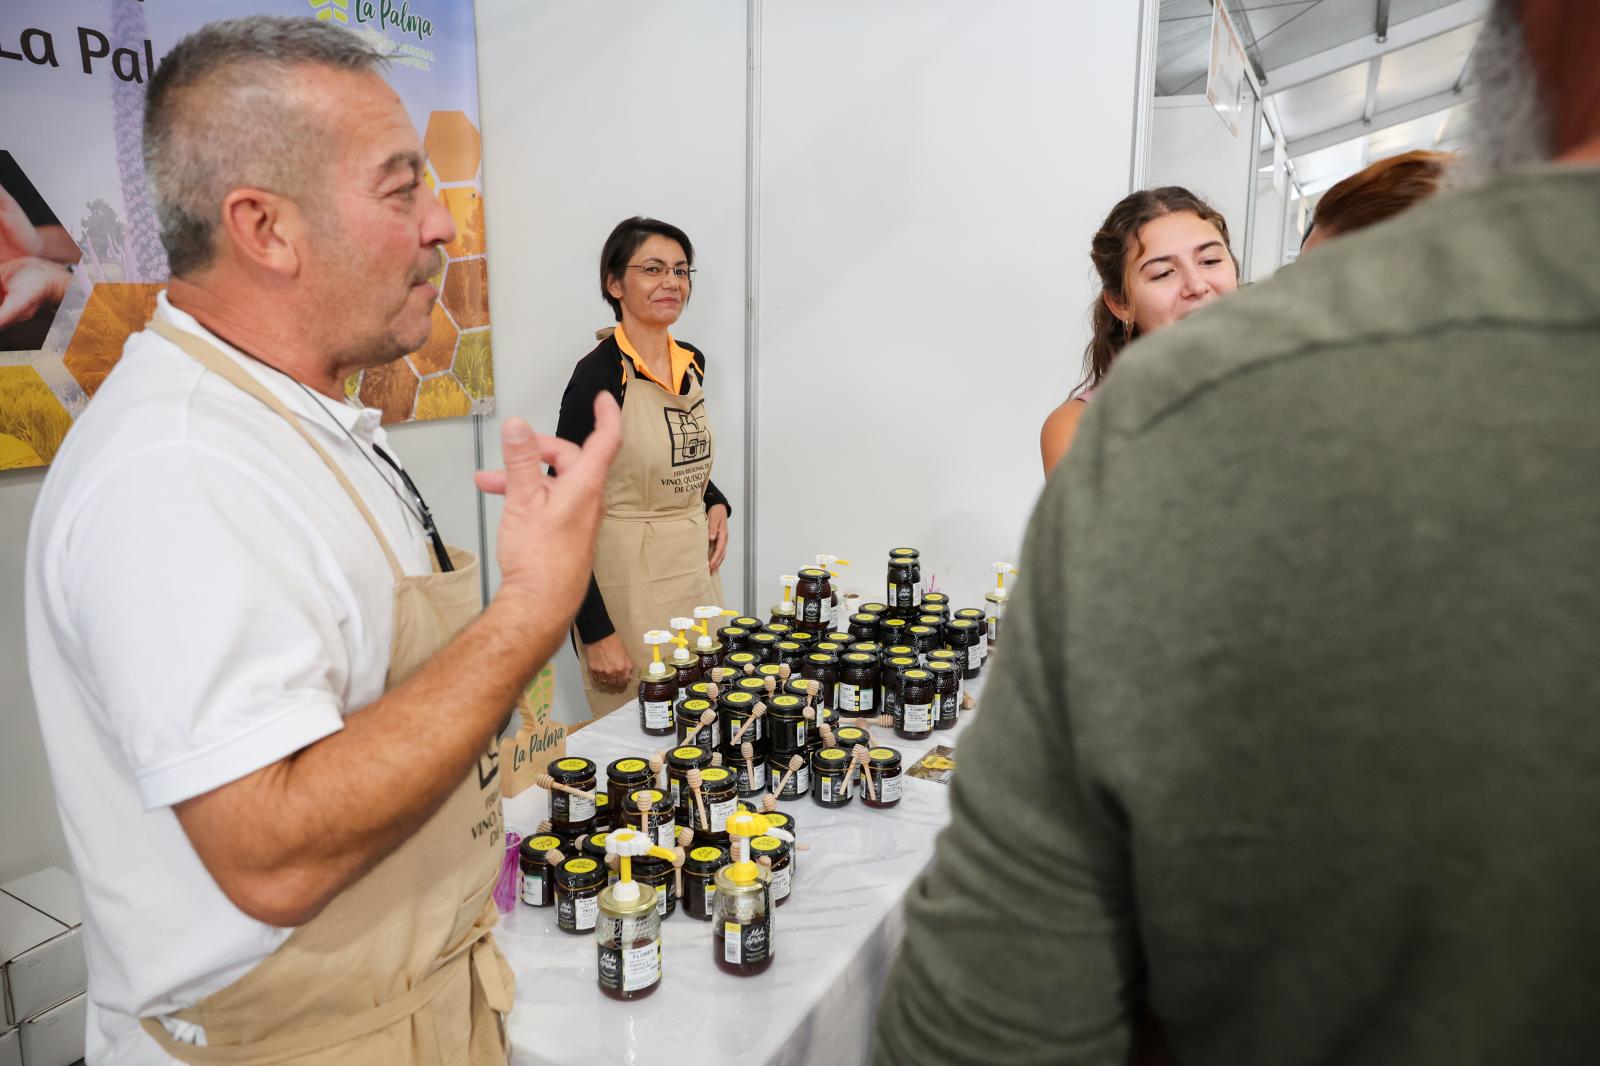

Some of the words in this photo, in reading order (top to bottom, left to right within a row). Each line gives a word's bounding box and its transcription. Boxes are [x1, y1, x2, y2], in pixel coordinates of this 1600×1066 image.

[355, 0, 375, 23] La
[380, 0, 433, 40] Palma
[514, 745, 525, 772] La
[530, 727, 564, 762] Palma
